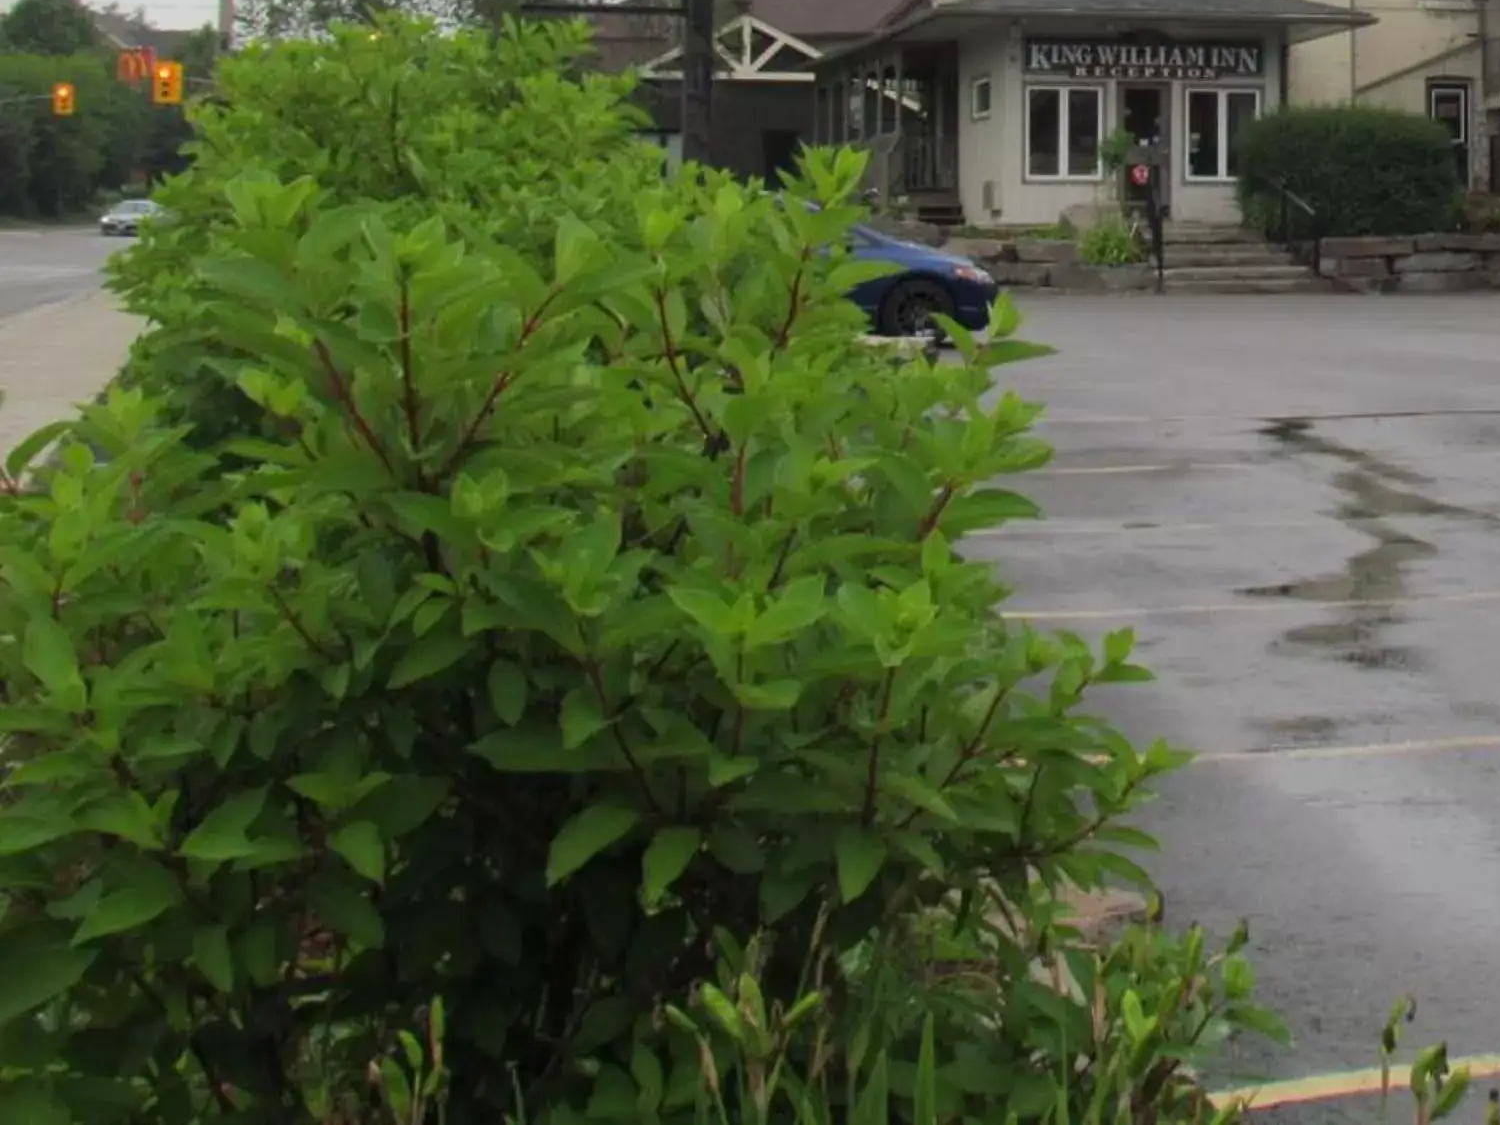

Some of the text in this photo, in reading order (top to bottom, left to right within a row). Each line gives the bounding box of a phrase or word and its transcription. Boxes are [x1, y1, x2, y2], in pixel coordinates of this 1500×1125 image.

[1029, 43, 1259, 73] KING WILLIAM INN
[1075, 66, 1216, 79] RECEPTION
